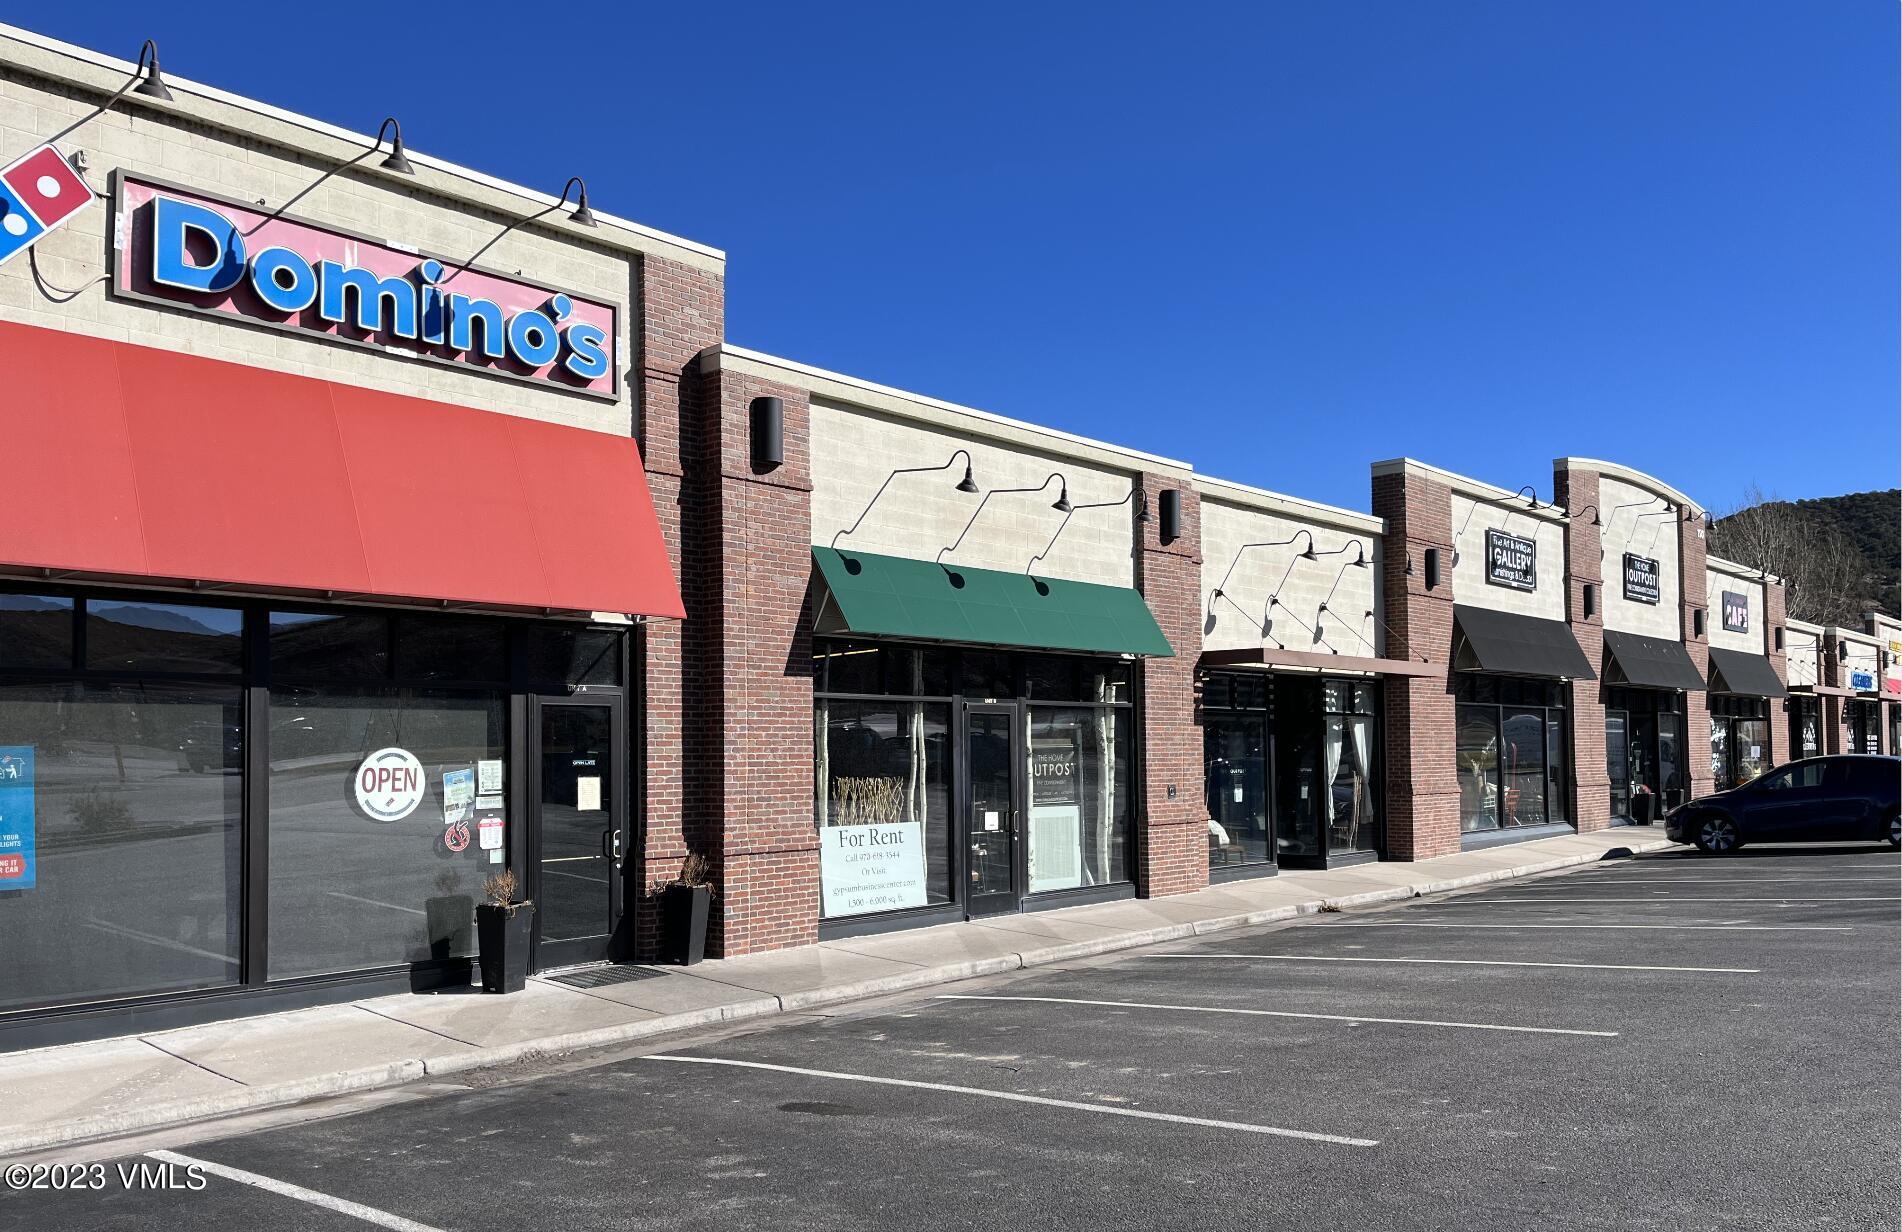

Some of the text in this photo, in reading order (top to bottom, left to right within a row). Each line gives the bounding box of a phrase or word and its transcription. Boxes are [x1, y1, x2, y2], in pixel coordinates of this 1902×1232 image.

[152, 194, 609, 380] Domino's
[1494, 547, 1532, 570] GALLERY
[1628, 569, 1657, 587] OUTPOST
[1037, 754, 1048, 762] THE
[1034, 762, 1077, 777] UTPOST
[361, 767, 418, 794] OPEN
[838, 828, 904, 848] For Rent
[10, 859, 17, 867] IT
[845, 853, 858, 862] Call
[5, 866, 19, 874] CAR
[861, 868, 870, 876] Or
